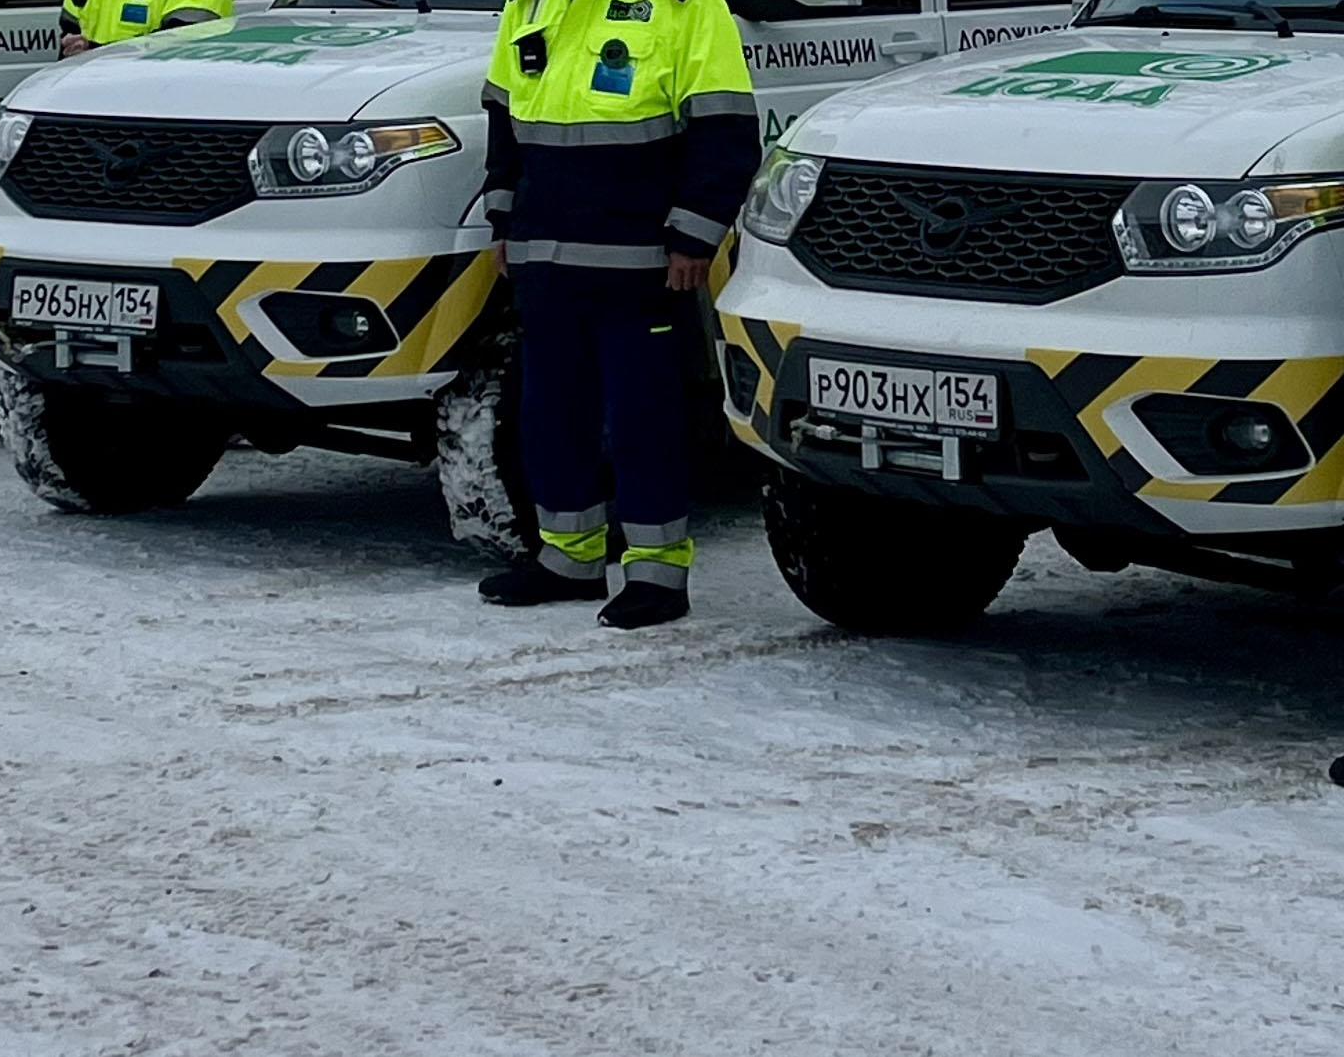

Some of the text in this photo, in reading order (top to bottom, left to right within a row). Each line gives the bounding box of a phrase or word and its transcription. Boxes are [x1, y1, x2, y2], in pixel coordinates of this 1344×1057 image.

[742, 38, 877, 70] РГАНИЗАЦИИ
[949, 76, 1176, 108] ЦОДД
[19, 284, 153, 320] Р965НХ 154
[818, 368, 988, 417] Р903НХ 154
[948, 409, 975, 421] RUS
